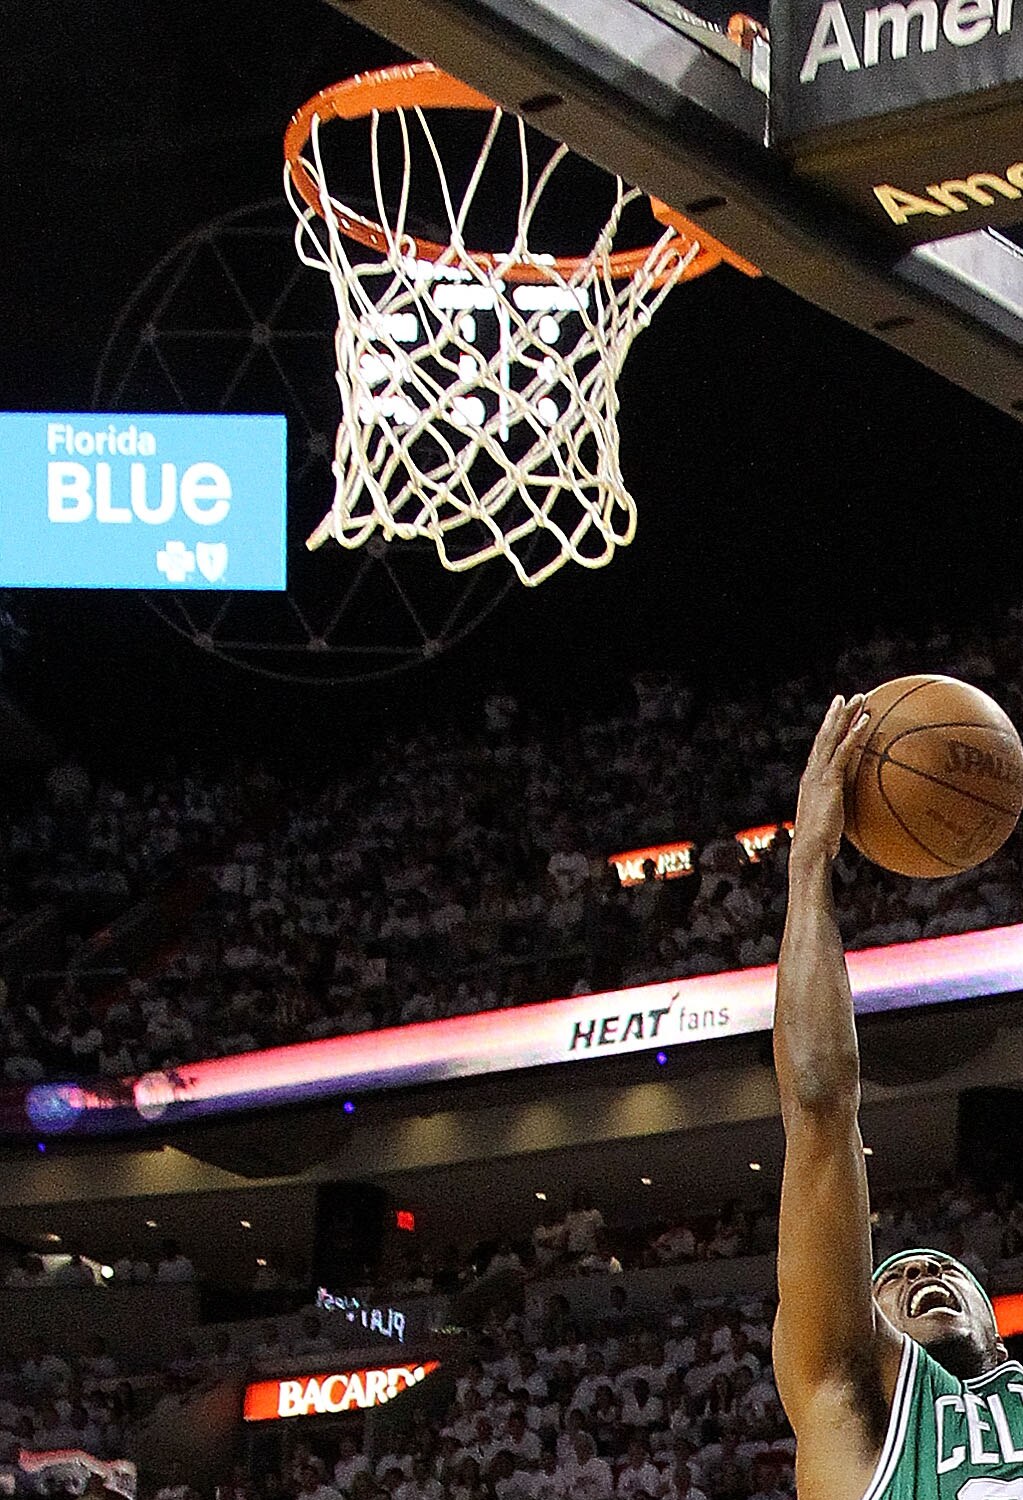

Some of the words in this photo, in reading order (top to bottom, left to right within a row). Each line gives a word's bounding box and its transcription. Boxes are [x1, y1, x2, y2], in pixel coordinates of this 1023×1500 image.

[46, 422, 157, 456] Florida
[568, 992, 680, 1052] HEAT
[679, 1006, 731, 1032] fans
